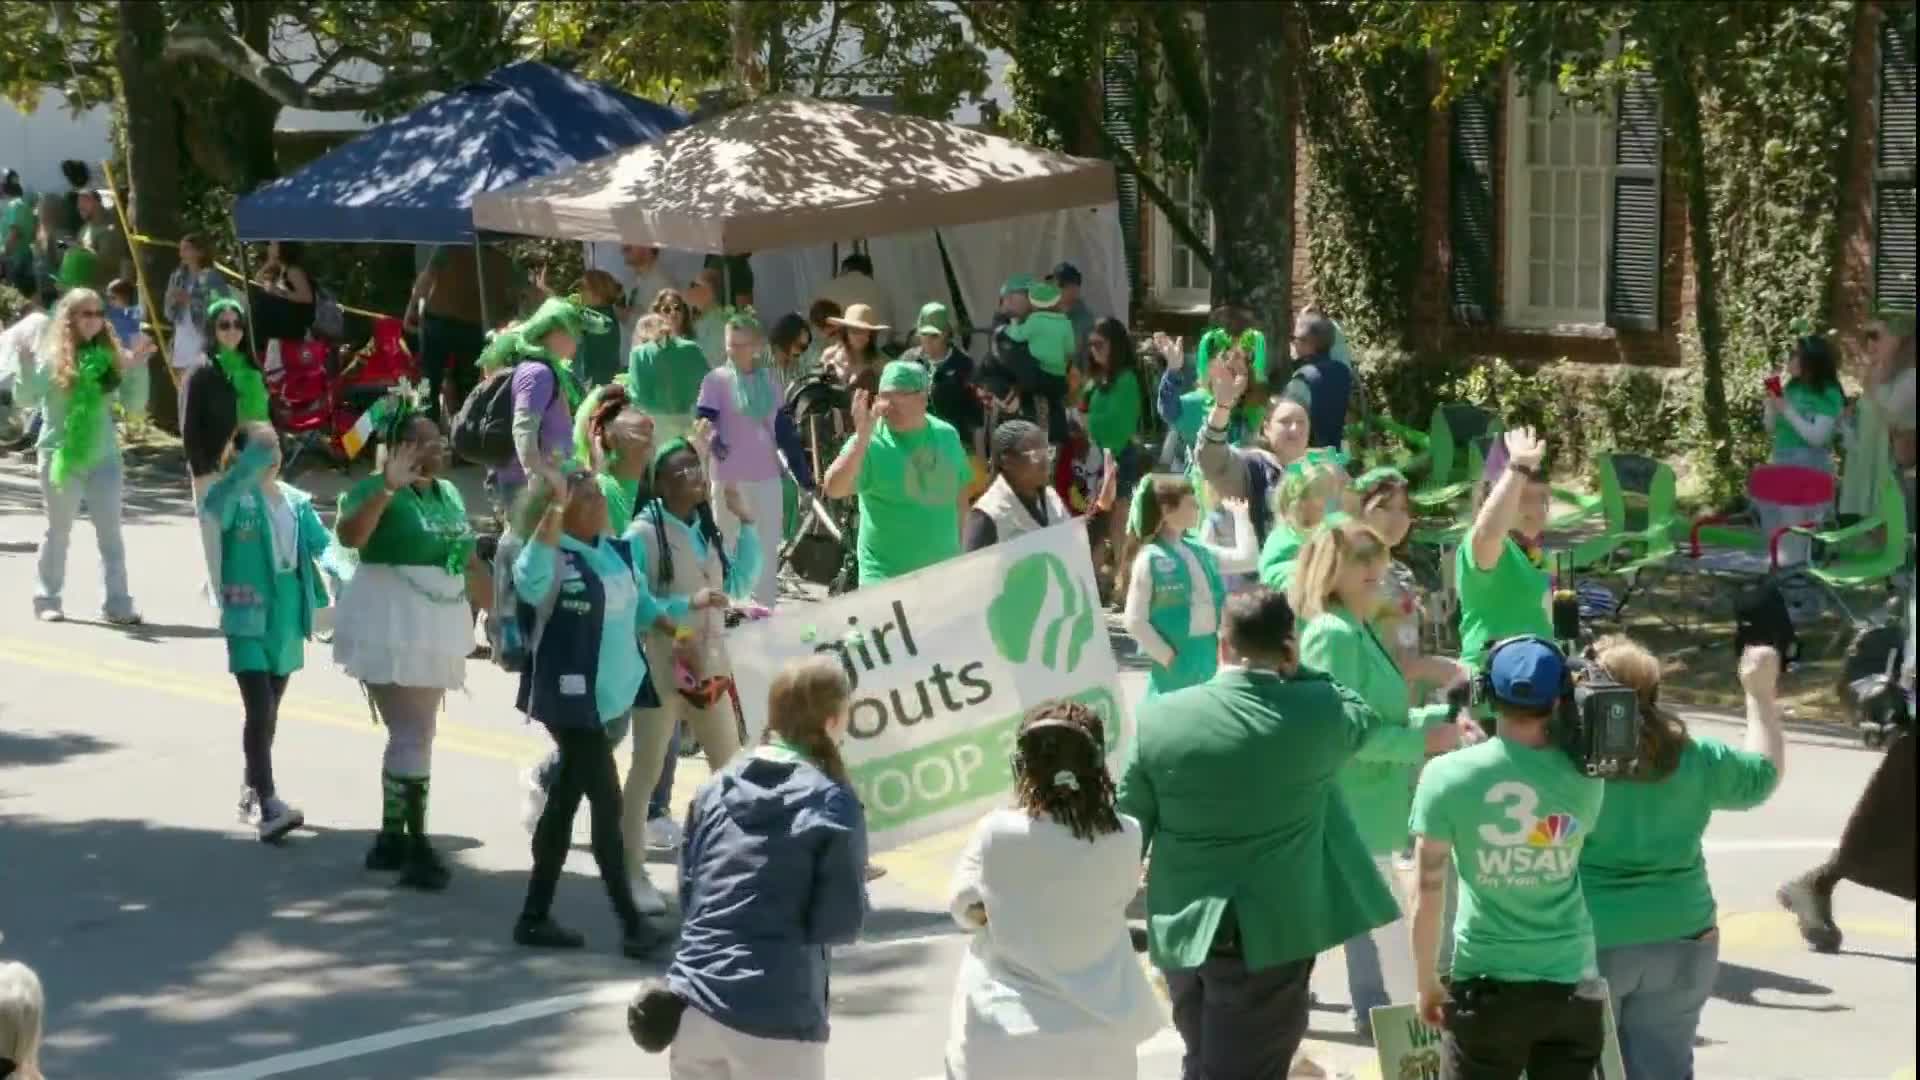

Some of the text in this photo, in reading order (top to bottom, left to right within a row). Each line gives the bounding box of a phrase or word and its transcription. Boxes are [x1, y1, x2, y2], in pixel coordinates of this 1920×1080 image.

[846, 661, 993, 739] outs
[866, 744, 983, 812] OOP
[1478, 781, 1539, 847] 3
[1476, 847, 1580, 877] WSAV
